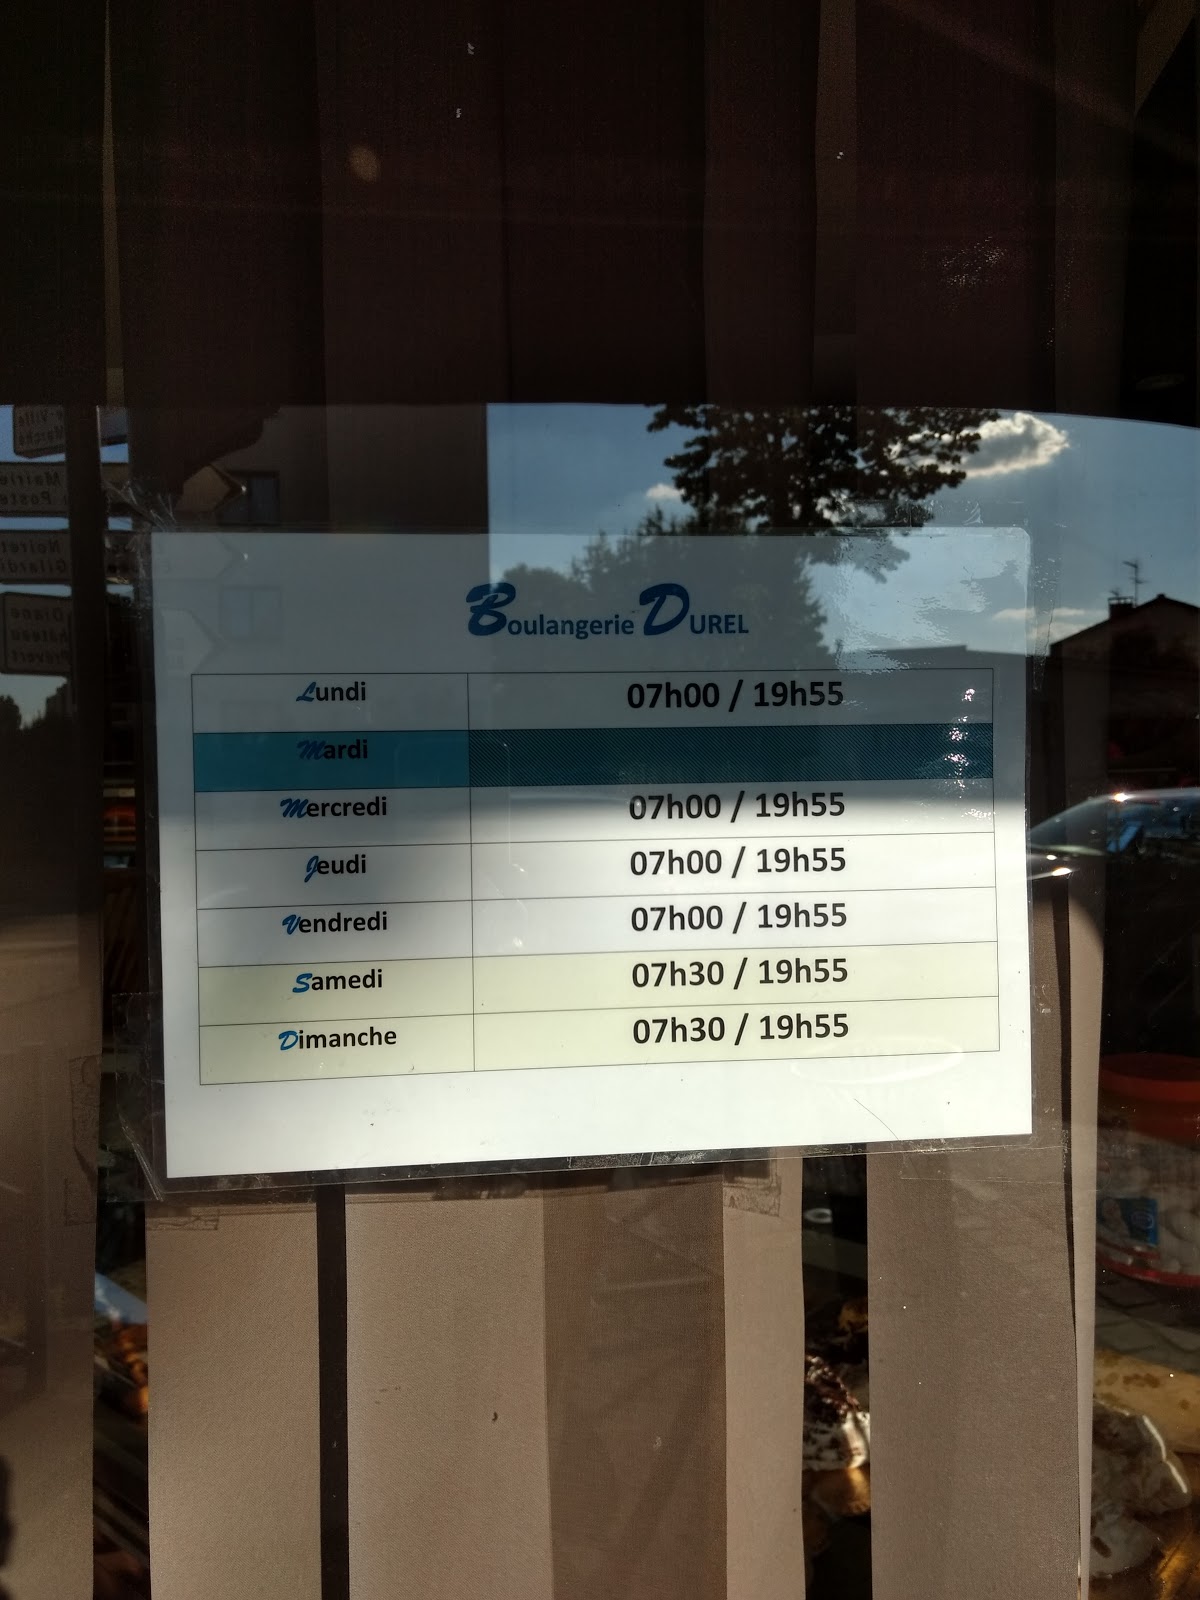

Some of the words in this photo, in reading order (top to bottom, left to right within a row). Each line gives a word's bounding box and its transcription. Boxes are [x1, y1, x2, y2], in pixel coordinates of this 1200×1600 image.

[466, 582, 634, 640] Boulangerie
[639, 582, 749, 636] DUREL
[296, 681, 366, 702] Lundi
[627, 682, 720, 709] 07h00
[728, 679, 744, 712] /
[754, 681, 844, 708] 19h55
[298, 738, 368, 761] Mardi
[280, 796, 387, 818] Mercredi
[629, 794, 722, 820] 07h00
[730, 791, 746, 823] /
[756, 792, 846, 818] 19h55
[304, 854, 367, 882] Jeudi
[630, 849, 722, 876] 07h00
[731, 846, 746, 878] /
[757, 847, 846, 873] 19h55
[282, 911, 388, 935] Vendredi
[631, 904, 723, 932] 07h00
[732, 901, 747, 934] /
[758, 902, 848, 929] 19h55
[292, 969, 383, 993] Samedi
[632, 961, 724, 988] 07h30
[733, 957, 748, 990] /
[759, 958, 848, 984] 19h55
[278, 1026, 397, 1051] Dimanche
[633, 1016, 725, 1044] 07h30
[734, 1013, 749, 1046] /
[760, 1013, 849, 1040] 19h55
